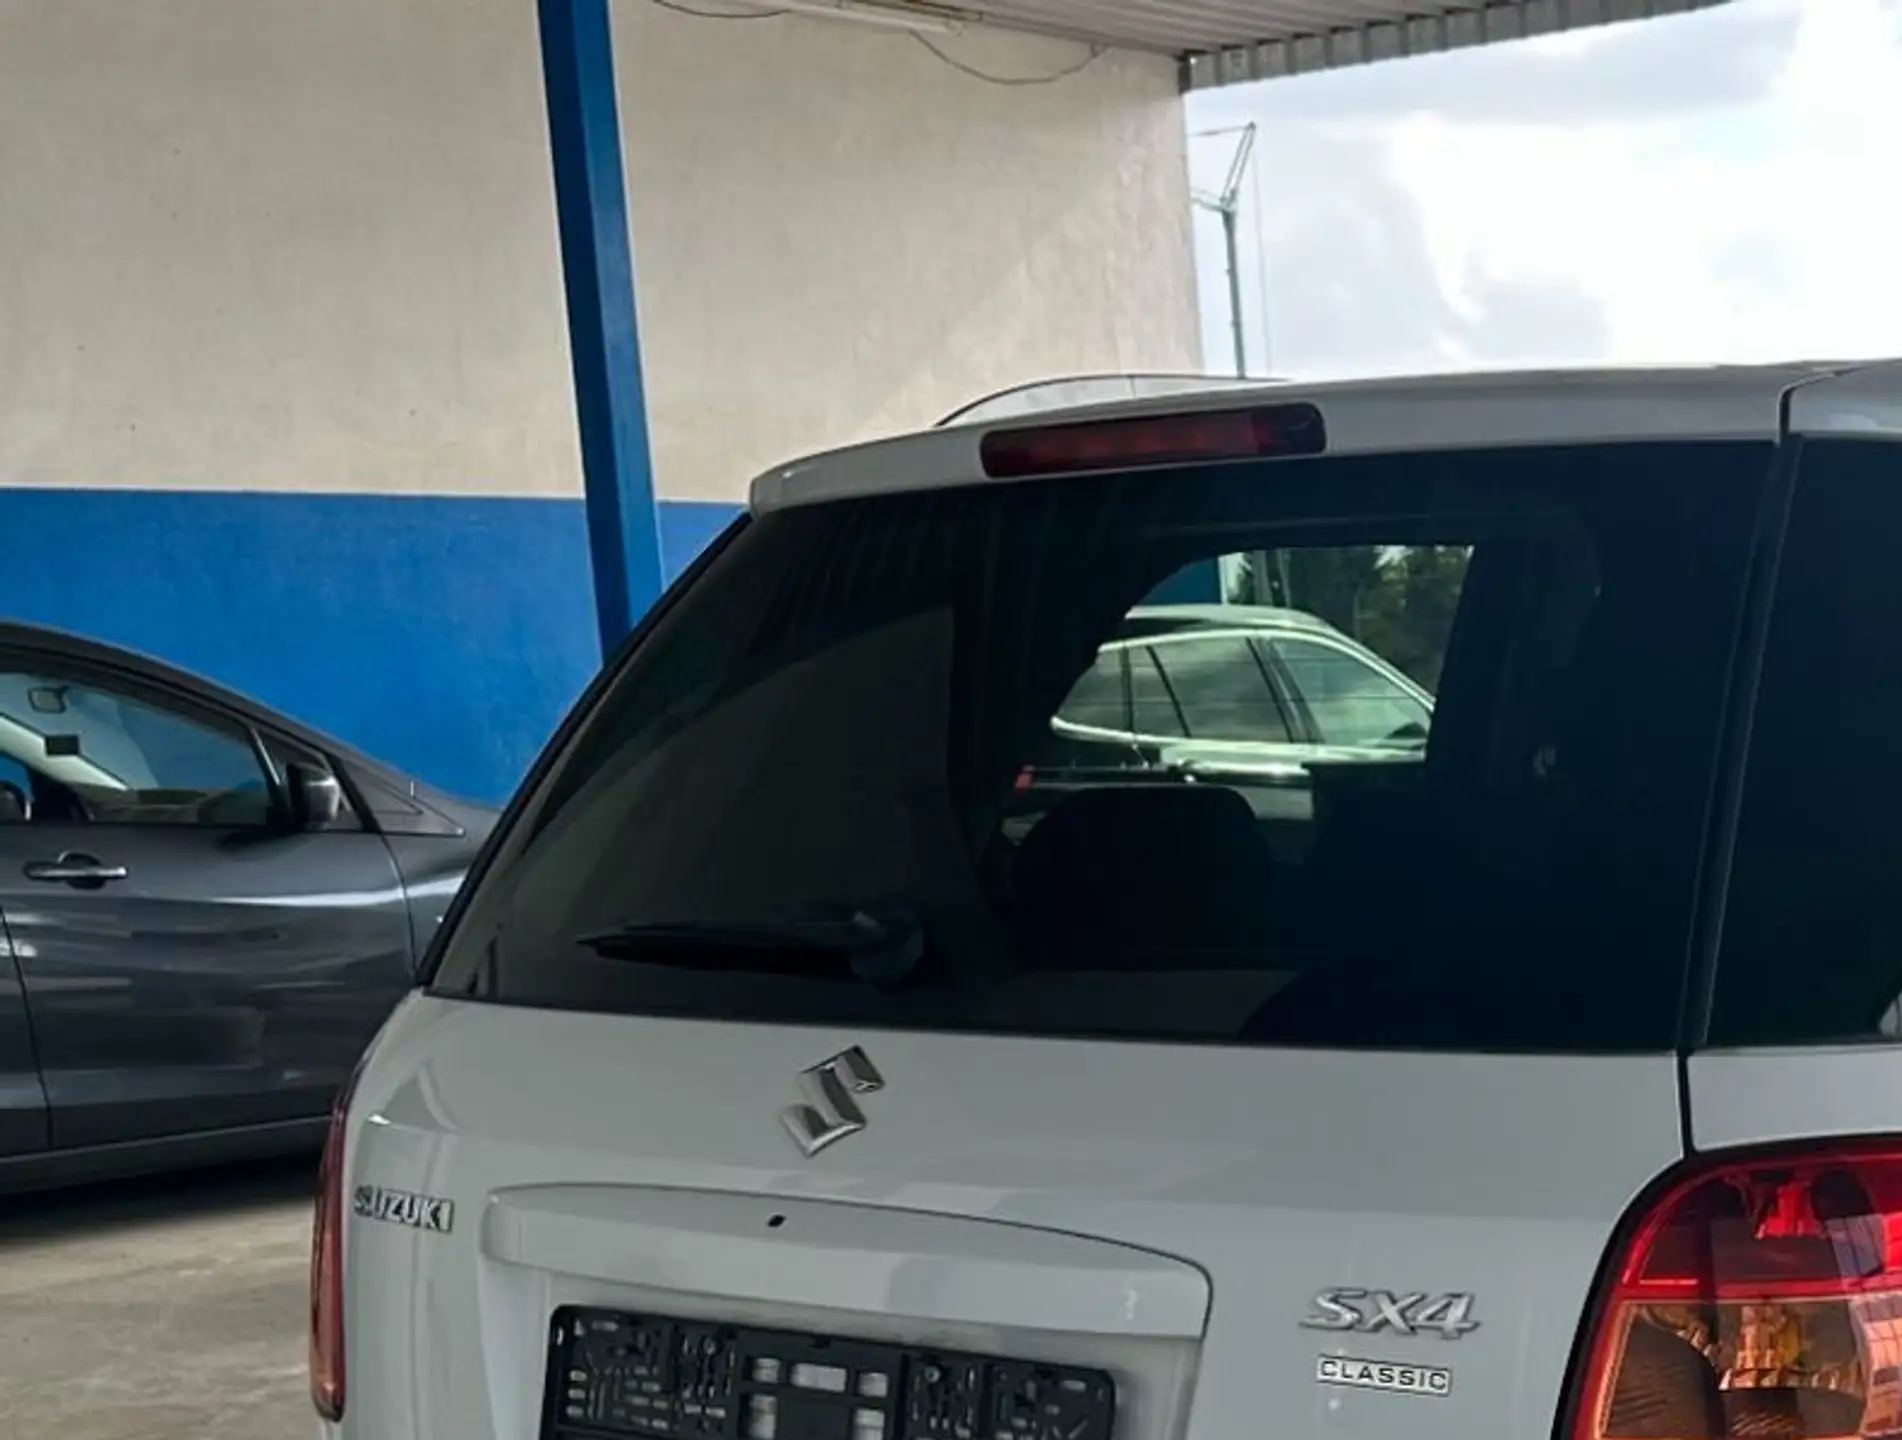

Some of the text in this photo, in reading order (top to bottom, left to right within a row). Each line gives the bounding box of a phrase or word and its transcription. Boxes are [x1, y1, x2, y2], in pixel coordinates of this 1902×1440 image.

[353, 1185, 454, 1234] SUZUKI
[1300, 1287, 1480, 1340] SX4
[1318, 1357, 1450, 1394] CLASSIC
